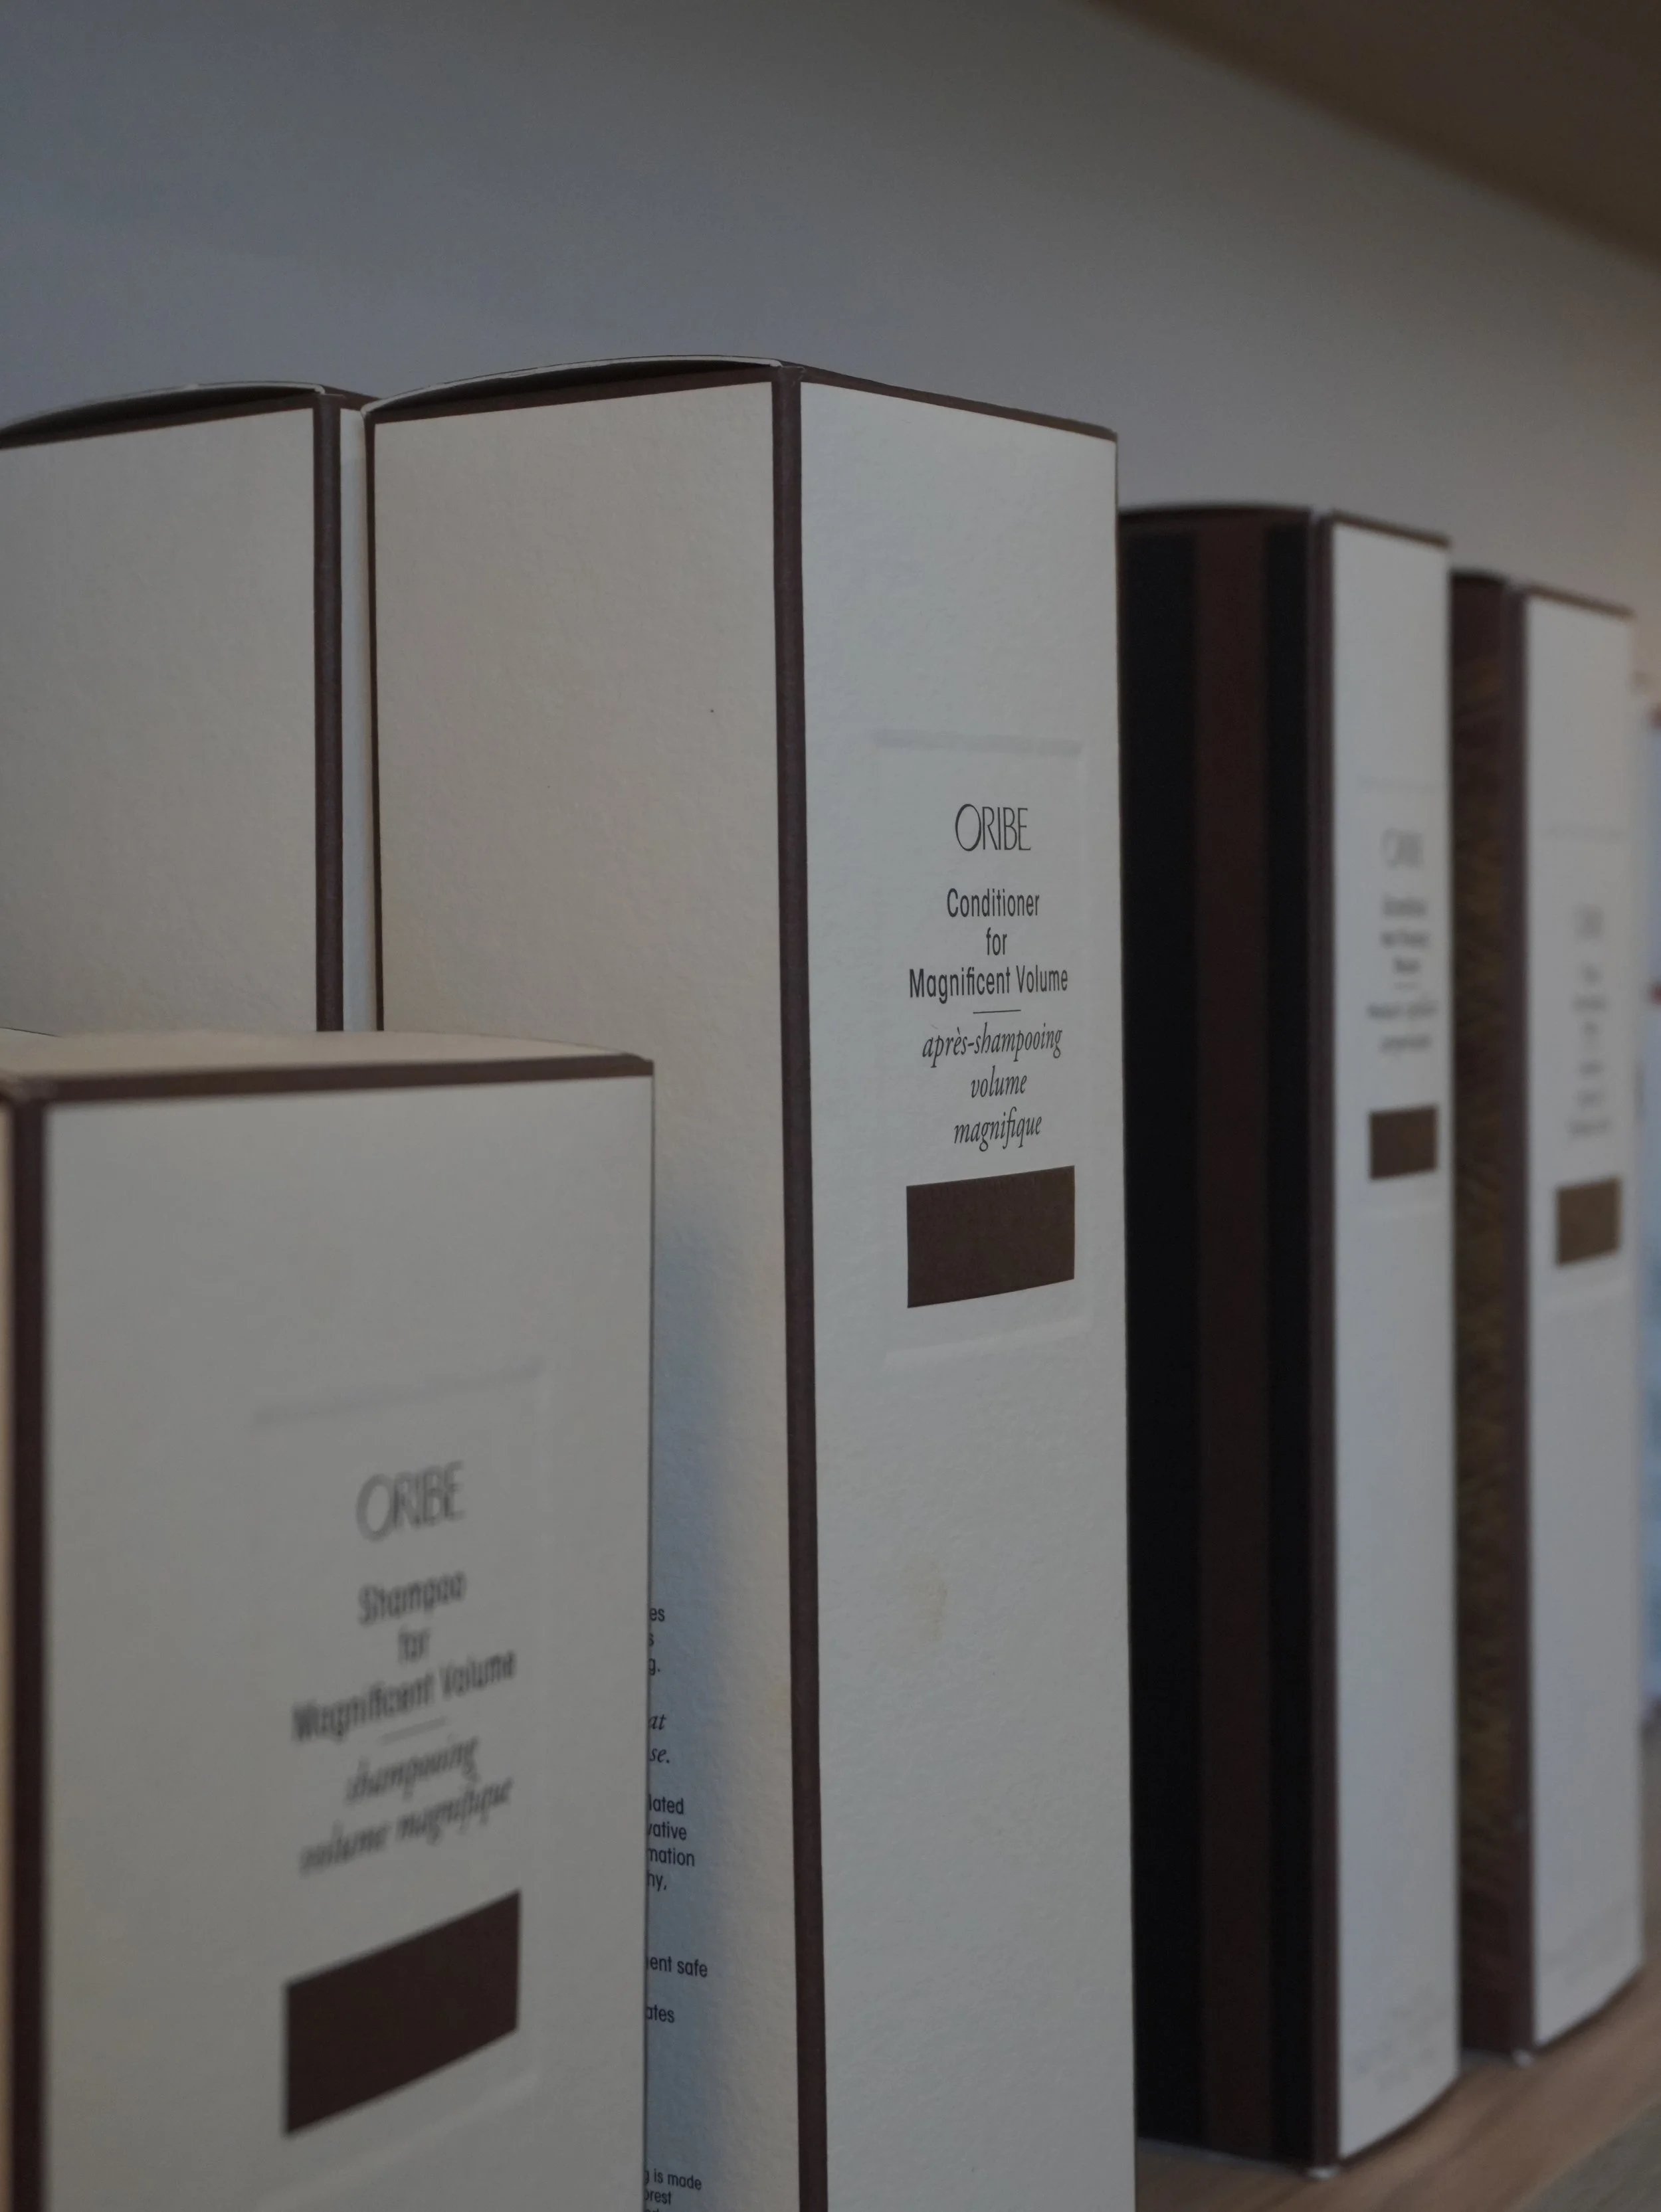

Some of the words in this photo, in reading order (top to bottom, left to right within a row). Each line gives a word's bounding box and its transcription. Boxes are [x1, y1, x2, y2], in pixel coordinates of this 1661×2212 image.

[955, 803, 1032, 852] ORIBE
[947, 887, 1040, 917] Conditioner
[986, 927, 1007, 955] for
[909, 967, 1011, 1004] Magnificent
[1016, 964, 1068, 993] Volume
[922, 1022, 1062, 1068] après-shampooing
[971, 1064, 1027, 1099] volume
[954, 1105, 1042, 1152] magnifique
[355, 1459, 467, 1543] ORIBE
[646, 1956, 672, 1973] ent
[676, 1958, 708, 1978] safe
[654, 2167, 664, 2184] is
[667, 2173, 704, 2191] made
